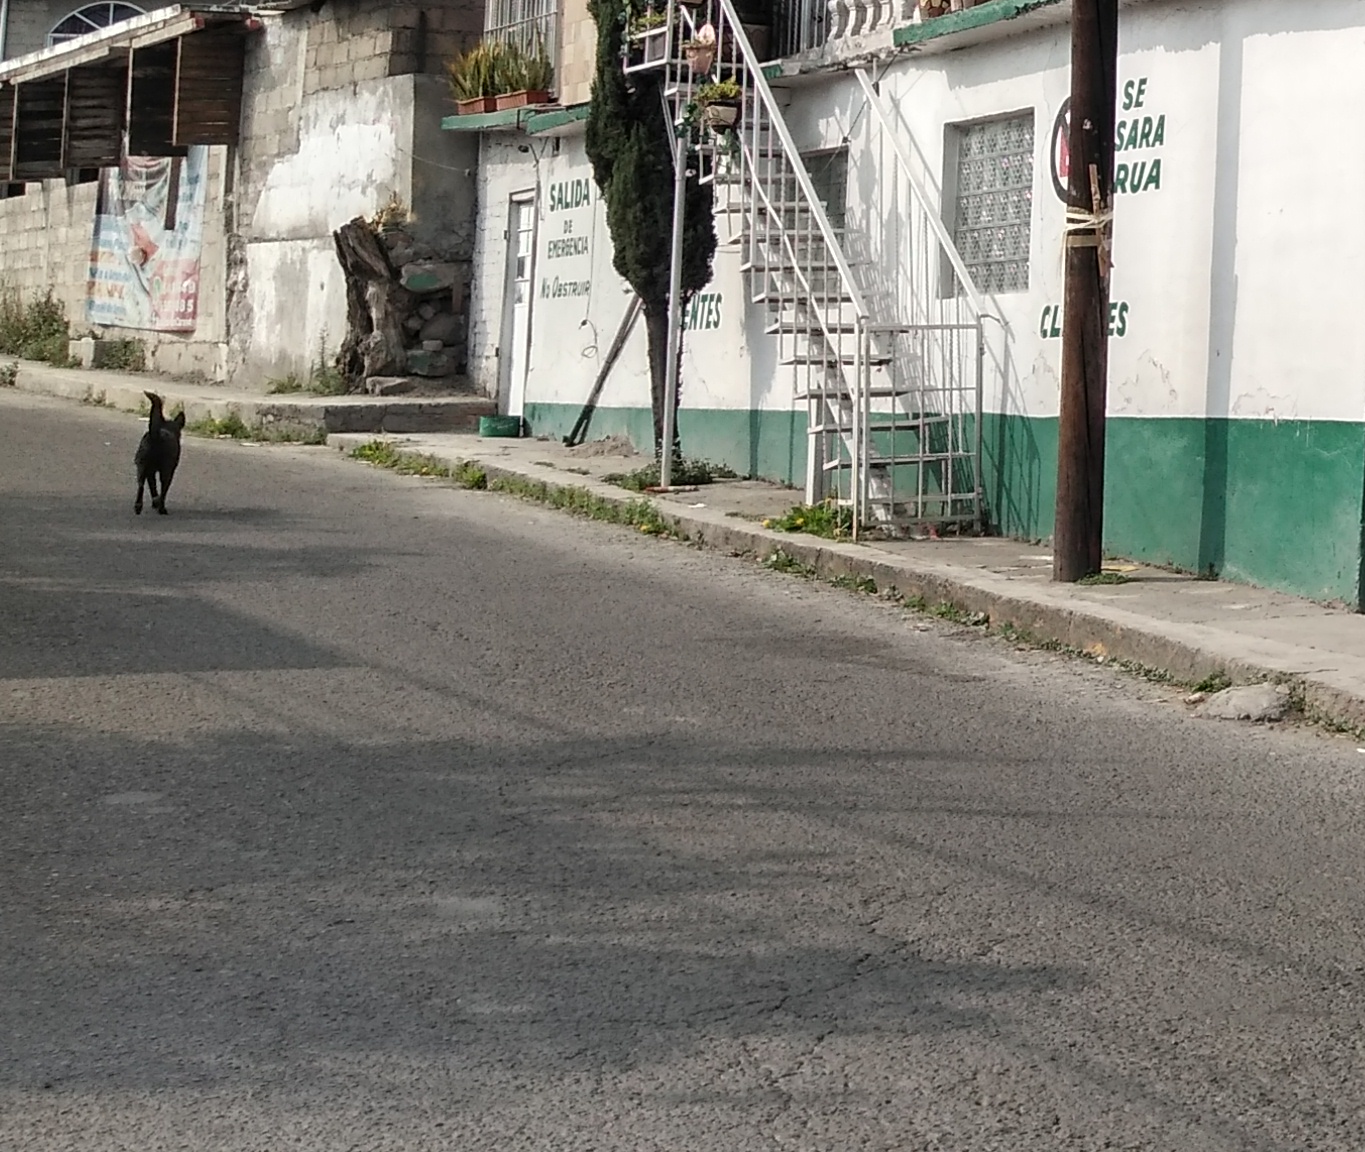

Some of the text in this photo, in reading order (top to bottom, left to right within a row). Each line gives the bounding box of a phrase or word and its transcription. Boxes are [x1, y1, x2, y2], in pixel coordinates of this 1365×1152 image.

[1122, 77, 1148, 111] SE
[1114, 114, 1166, 152] SARA
[1112, 158, 1161, 194] RUA
[549, 177, 591, 212] SALIDA
[563, 220, 573, 234] DE
[547, 235, 589, 260] EMERGENCIA
